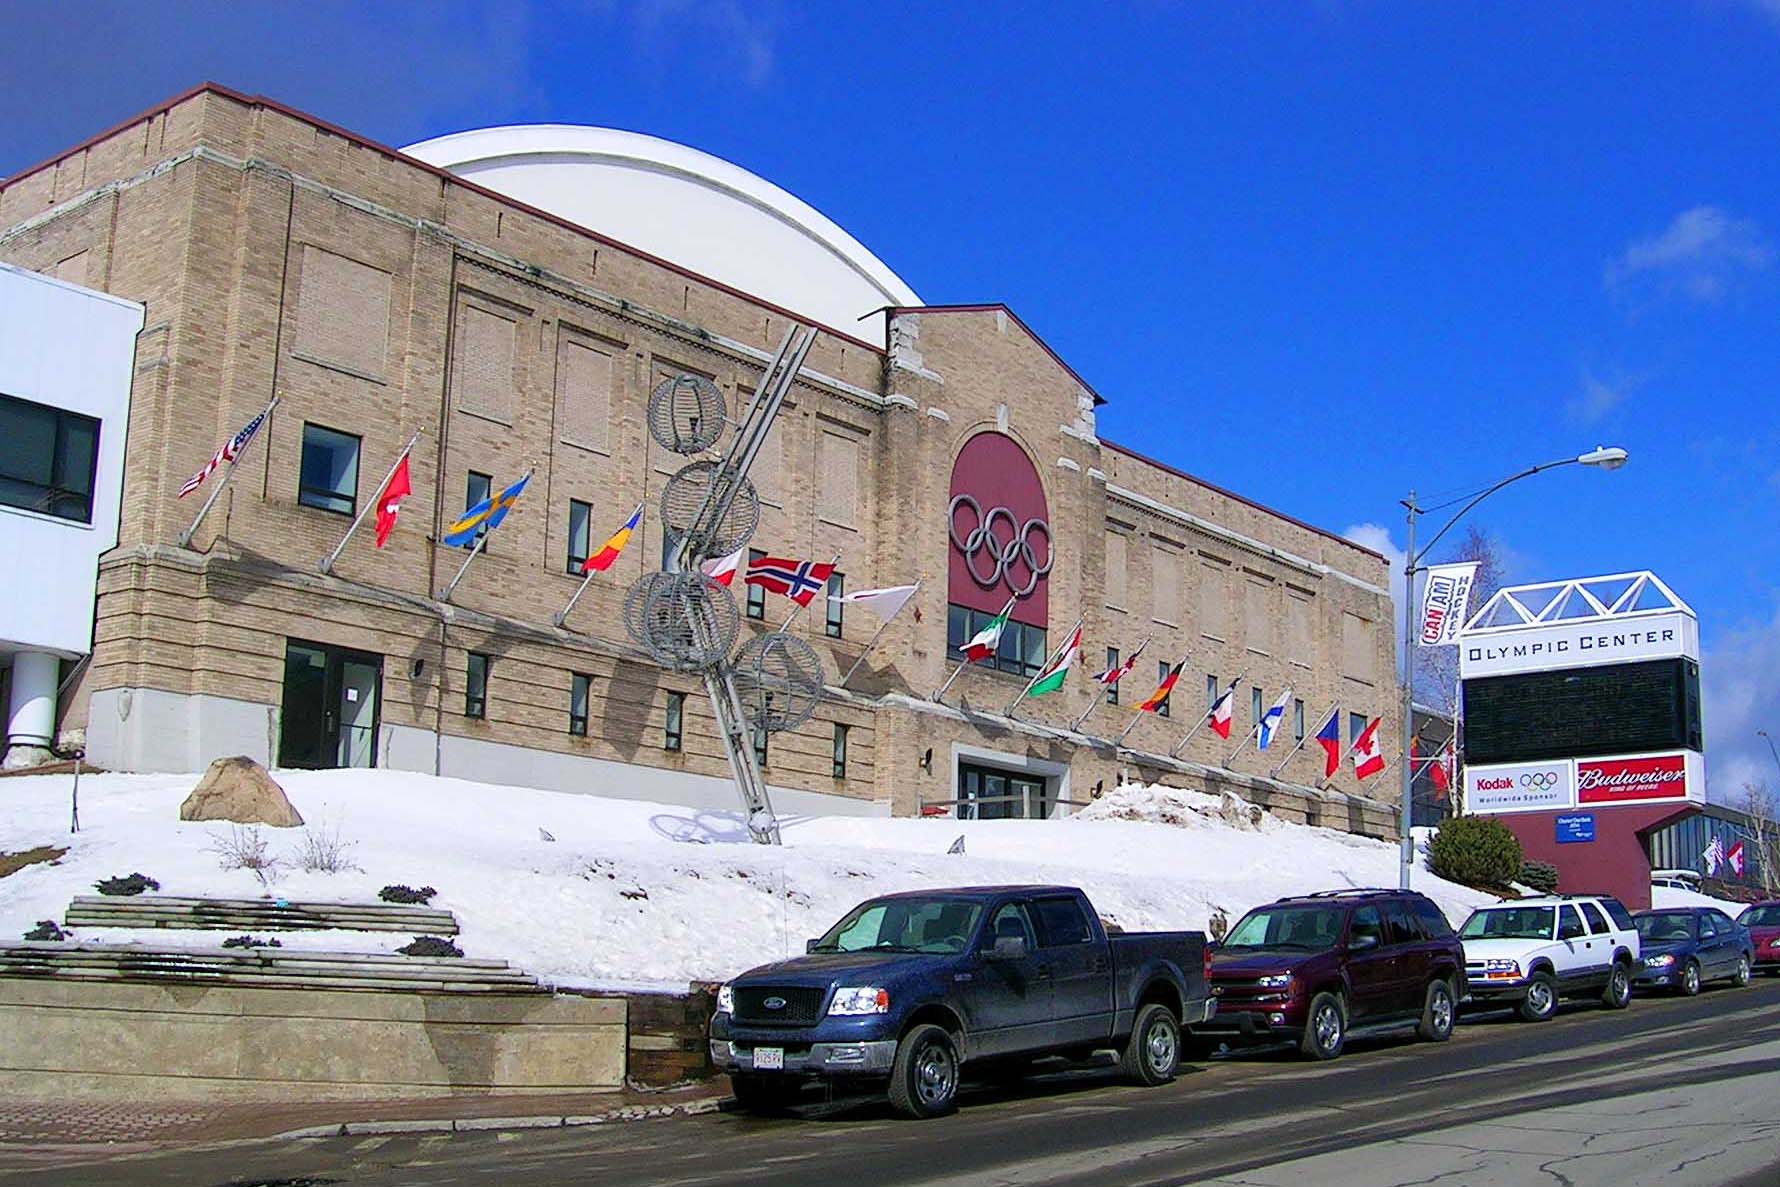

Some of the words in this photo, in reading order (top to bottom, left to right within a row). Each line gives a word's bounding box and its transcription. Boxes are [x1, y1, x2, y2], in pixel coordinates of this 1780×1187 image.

[1447, 576, 1469, 640] HOCKEY
[1469, 640, 1569, 662] OLYMPIC
[1580, 629, 1674, 650] CENTER
[1477, 777, 1514, 791] Kodak
[1578, 767, 1686, 790] Budweiser
[1479, 795, 1521, 804] Worldwide
[1523, 793, 1557, 802] Sponsor
